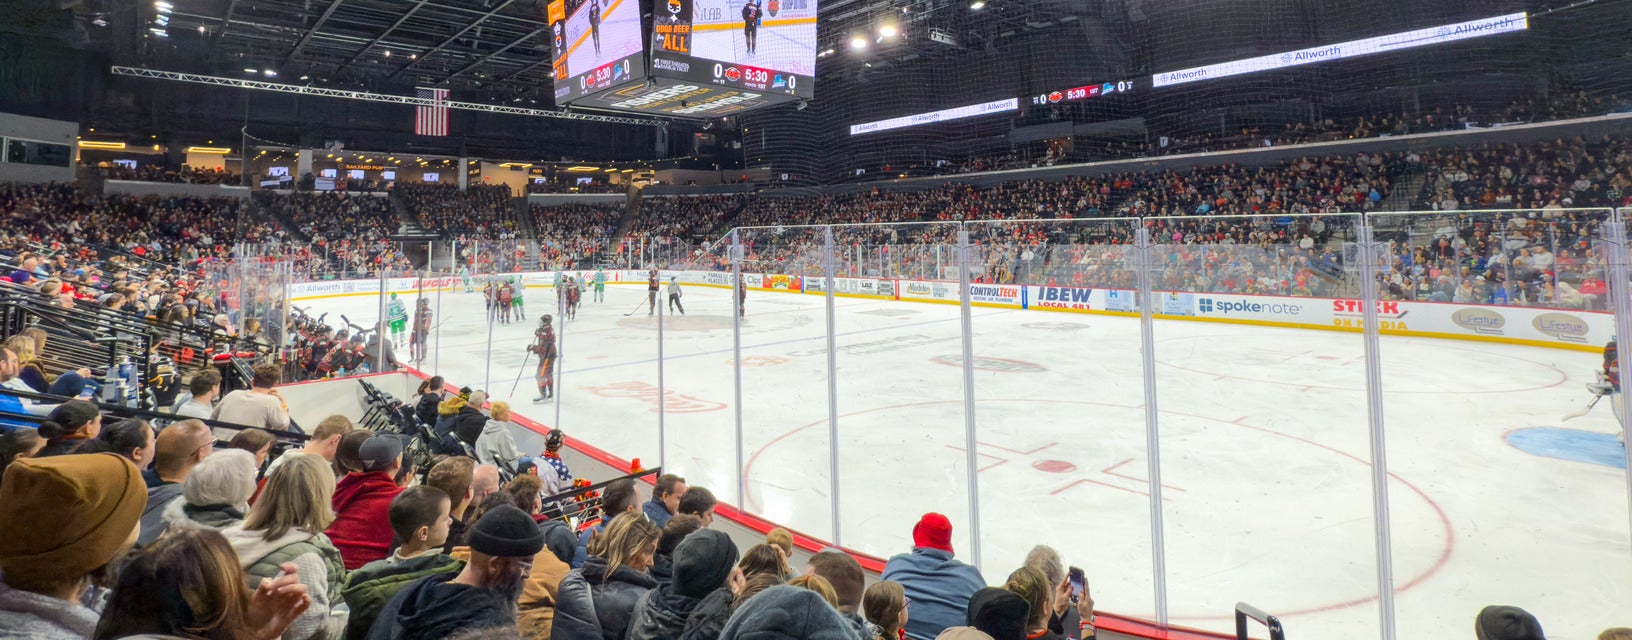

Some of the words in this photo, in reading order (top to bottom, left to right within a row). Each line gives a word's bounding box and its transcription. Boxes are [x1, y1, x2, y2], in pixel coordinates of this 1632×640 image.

[1454, 17, 1514, 34] Allworth
[662, 33, 689, 53] ALL
[1294, 46, 1341, 61] Allworth
[581, 75, 586, 89] 0
[596, 66, 611, 81] 5:30
[624, 59, 630, 74] 0
[714, 63, 723, 78] 0
[745, 69, 768, 82] 5:30
[788, 75, 796, 89] 0
[1170, 69, 1207, 81] Allworth
[1040, 94, 1047, 104] 0
[1067, 89, 1085, 99] 5:30
[1117, 81, 1125, 92] 0
[987, 101, 1013, 111] Allworth
[306, 284, 341, 292] Allworth
[970, 285, 1018, 298] CONTROLTECH
[1038, 287, 1091, 303] IBEW
[388, 305, 401, 317] 43
[1037, 301, 1069, 309] LOCAL
[1216, 298, 1300, 315] spokenote
[1333, 299, 1399, 314] STIK
[1333, 318, 1352, 328] ON
